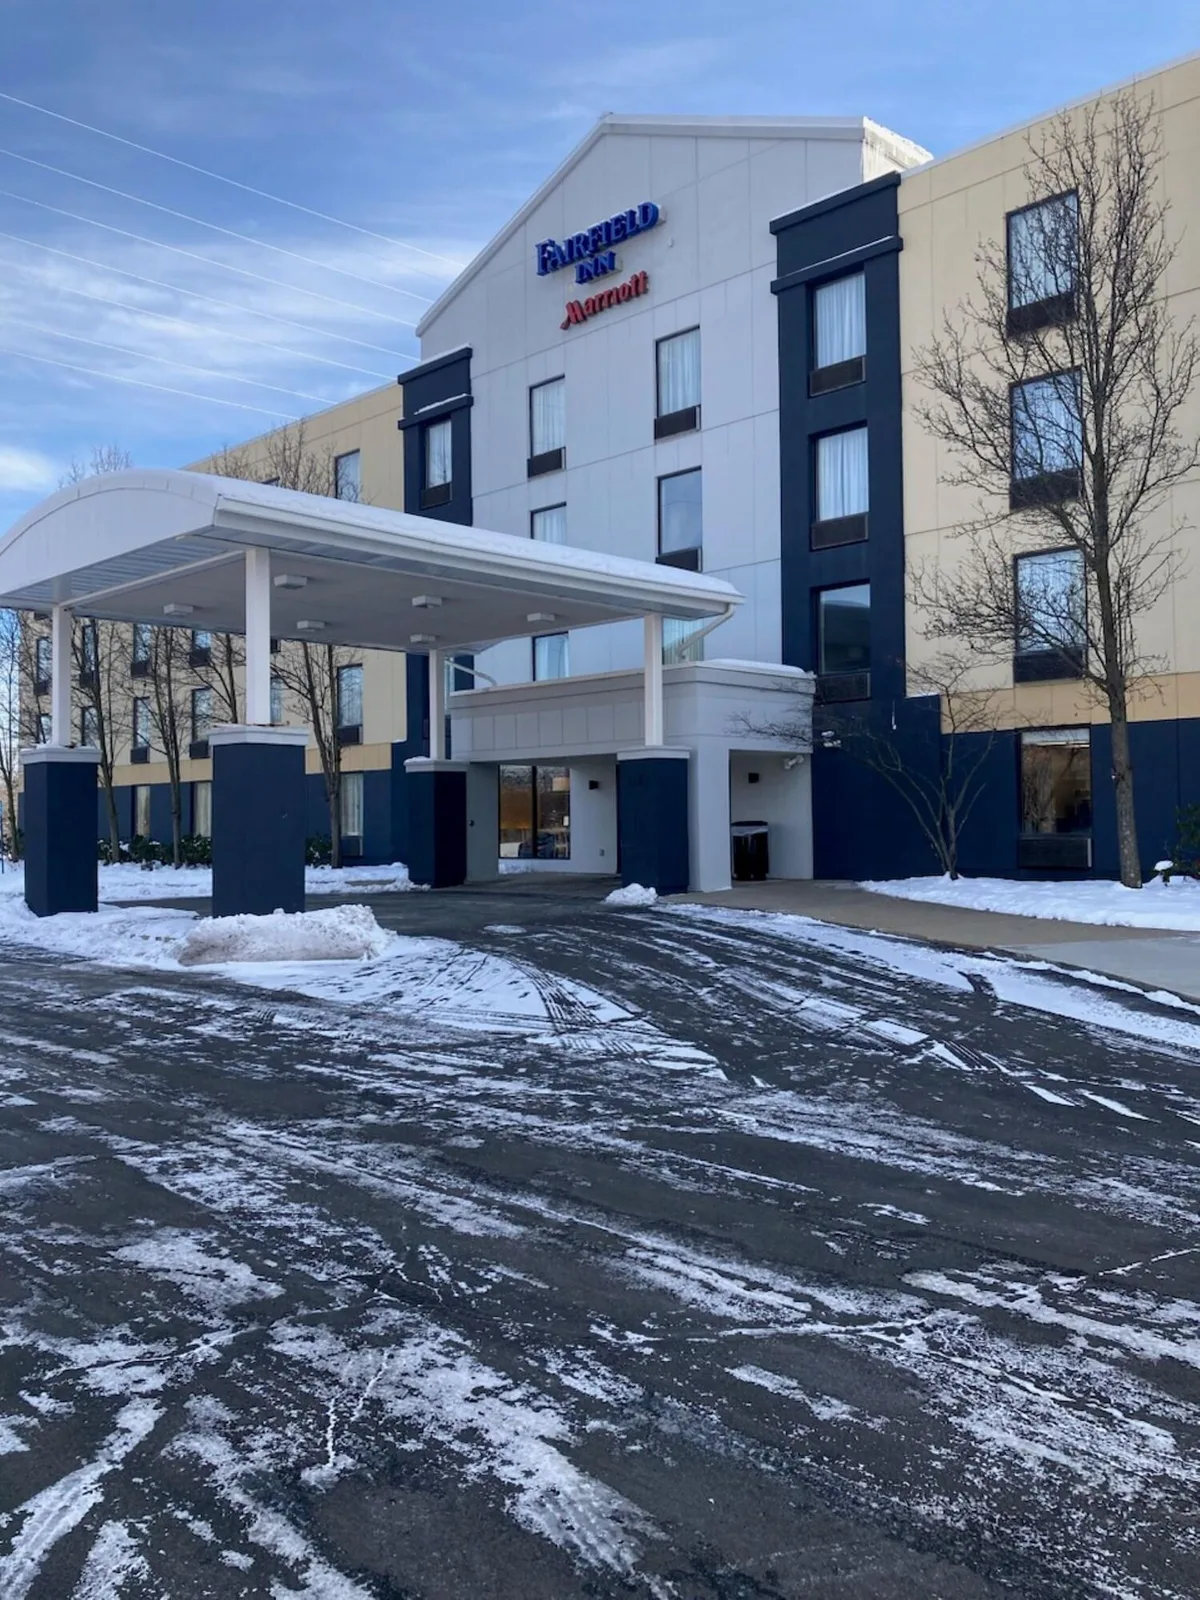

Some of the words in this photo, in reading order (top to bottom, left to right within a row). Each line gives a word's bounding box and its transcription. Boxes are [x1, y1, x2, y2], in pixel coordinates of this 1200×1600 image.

[536, 202, 659, 276] FAIRFIELD
[575, 251, 615, 284] INN
[561, 270, 648, 330] Marriott
